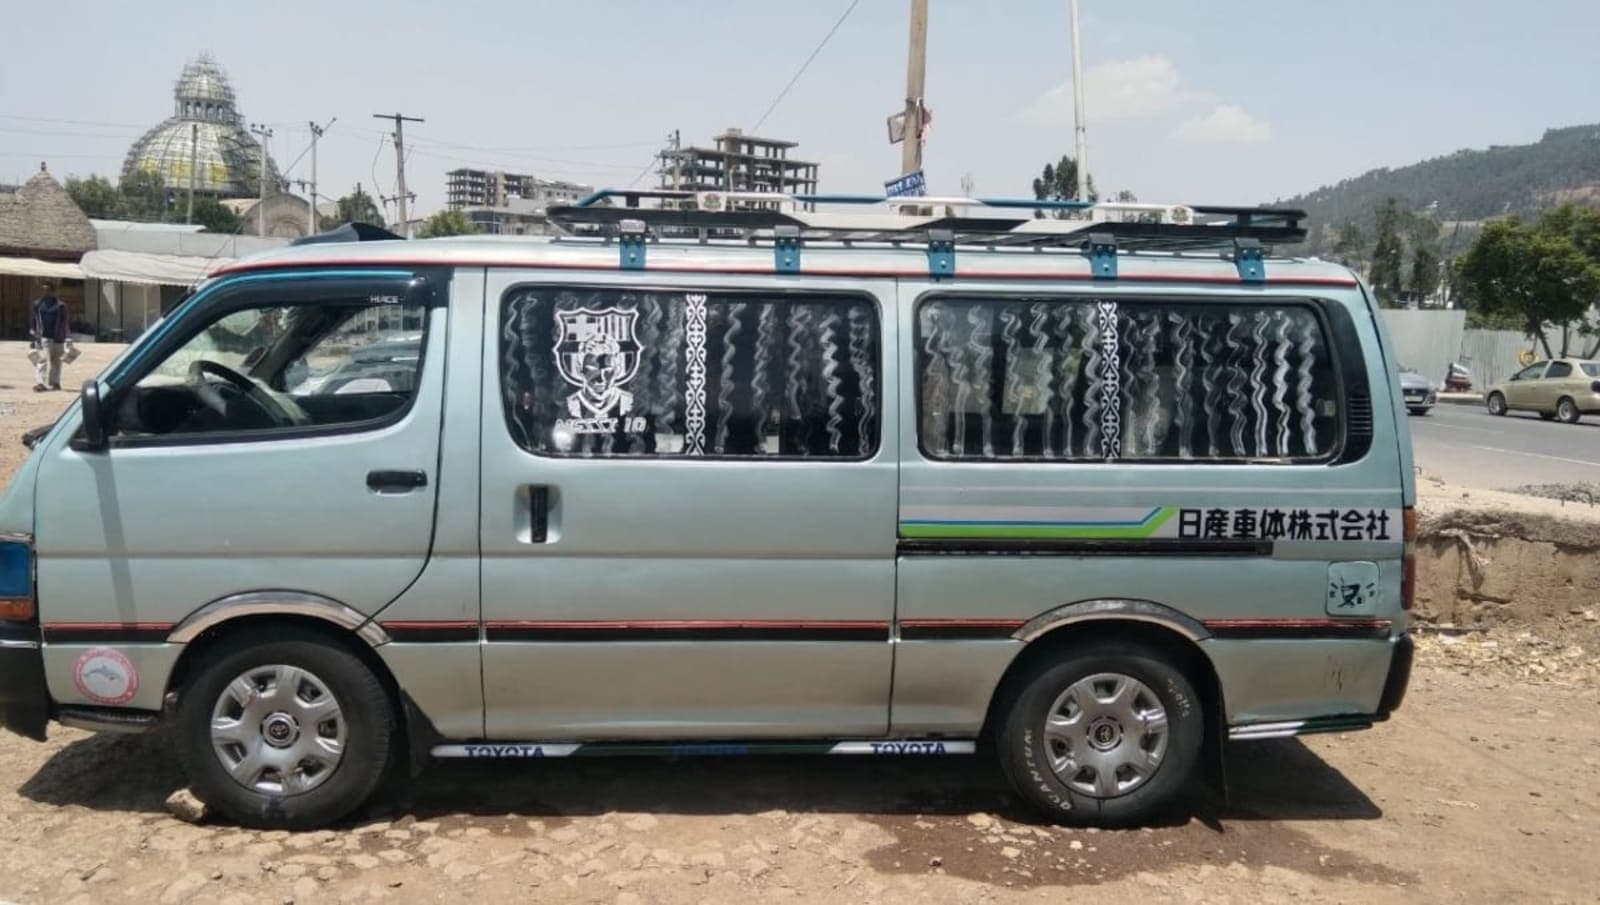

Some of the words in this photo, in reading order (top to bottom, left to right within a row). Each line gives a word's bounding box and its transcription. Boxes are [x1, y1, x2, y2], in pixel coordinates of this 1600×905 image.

[623, 416, 648, 434] 10
[1178, 507, 1391, 541] 日産車体株式会社
[464, 745, 545, 758] TOYOTA
[870, 742, 947, 756] TOYOTA
